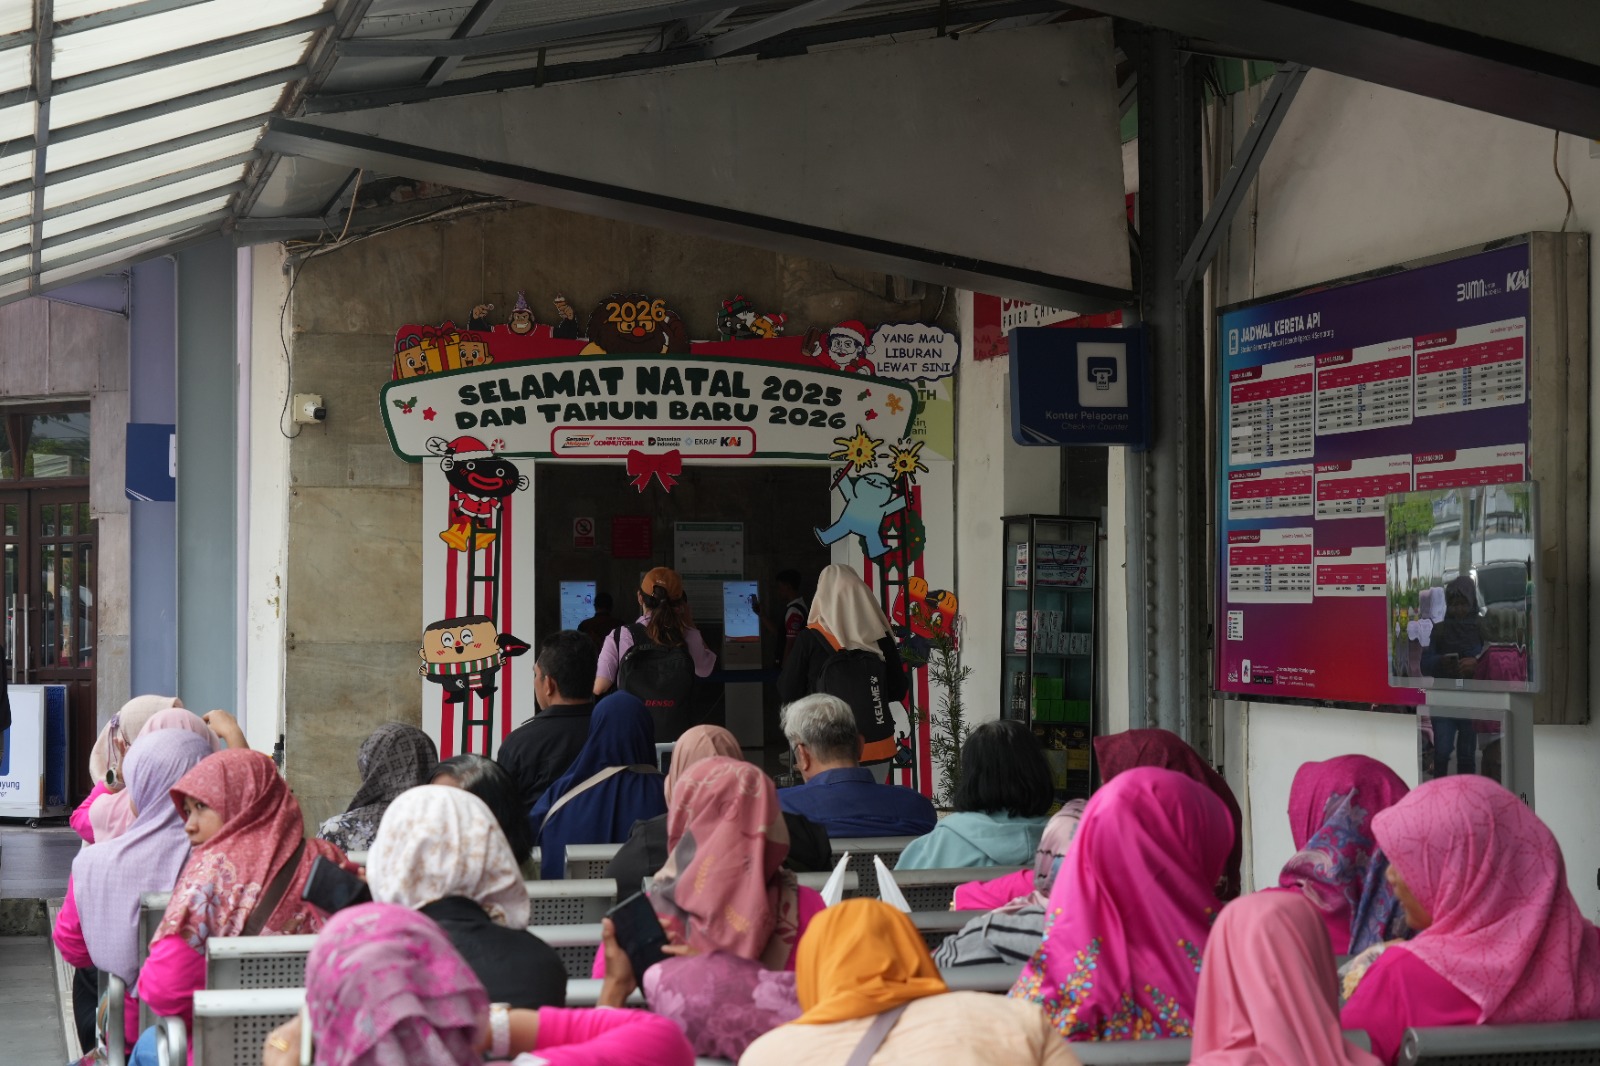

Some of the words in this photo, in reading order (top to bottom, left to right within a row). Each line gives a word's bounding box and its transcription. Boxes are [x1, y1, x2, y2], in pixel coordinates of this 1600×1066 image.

[1506, 268, 1530, 293] KAI
[606, 299, 666, 322] 2026
[1003, 310, 1028, 328] FRIED
[1240, 322, 1273, 343] JADWAL
[1274, 315, 1305, 337] KERETA
[1306, 311, 1321, 330] API
[881, 333, 914, 344] YANG
[919, 333, 944, 343] MAU
[885, 347, 942, 359] LIBURAN
[877, 362, 917, 373] LEWAT
[921, 362, 951, 373] SINI
[458, 366, 625, 406] SELAMAT
[637, 366, 751, 398] NATAL
[761, 375, 843, 407] 2025
[455, 406, 527, 430] DAN
[537, 401, 657, 423] TAHUN
[669, 401, 759, 422] BARU
[768, 405, 847, 429] 2026
[1045, 410, 1079, 420] Konter
[1080, 410, 1129, 422] Pelaporan
[1061, 422, 1096, 431] Check-in
[1097, 422, 1129, 431] Counter
[694, 438, 718, 446] EKRAF
[645, 698, 676, 708] DENSO
[871, 684, 885, 725] KELME
